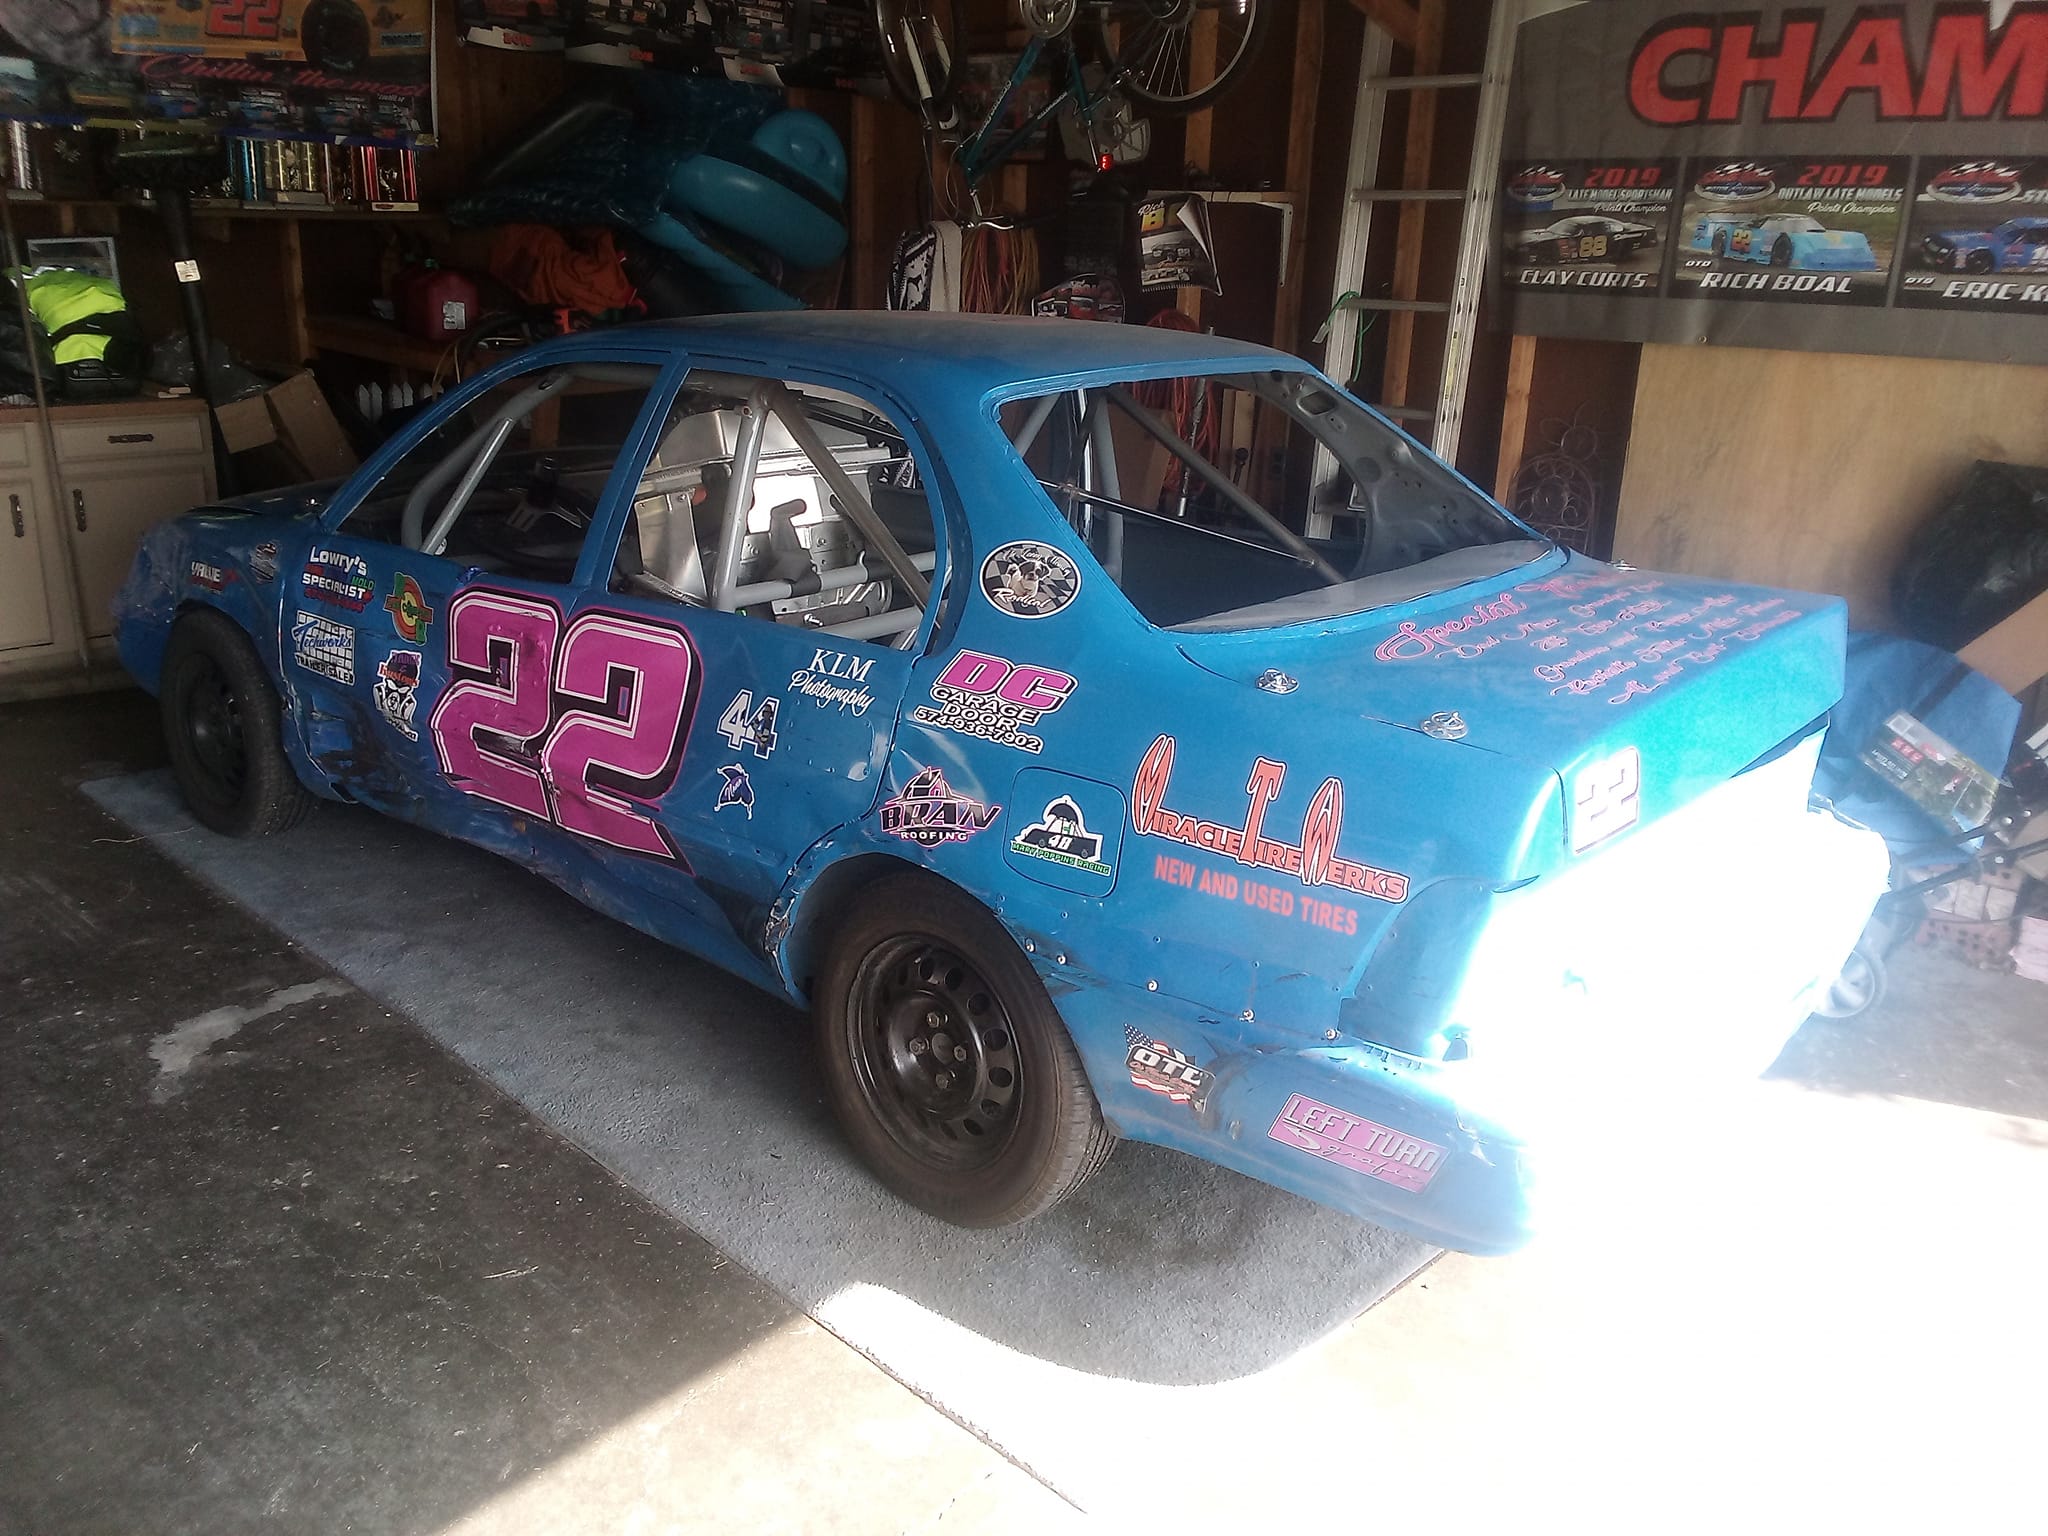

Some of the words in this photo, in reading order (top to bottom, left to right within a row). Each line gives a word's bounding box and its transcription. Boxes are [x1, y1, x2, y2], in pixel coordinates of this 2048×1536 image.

[1584, 167, 1662, 188] 2019
[1796, 164, 1889, 186] 2019
[1568, 188, 1590, 200] LATE
[1623, 202, 1668, 214] Champion
[1777, 187, 1826, 200] OUTLAW
[1826, 187, 1854, 200] LATE
[1855, 187, 1904, 202] MODELS
[1806, 201, 1842, 215] Points
[1841, 201, 1896, 216] Champion
[1578, 235, 1608, 258] 88
[1519, 269, 1575, 286] CLAY
[1576, 270, 1650, 289] CURTS
[1700, 271, 1769, 291] RICH
[1771, 274, 1853, 294] BOAL
[1942, 280, 2019, 301] ERIC
[191, 560, 221, 583] VALUE
[309, 545, 368, 577] Lowry's
[302, 572, 367, 601] SPECIALIST
[1375, 591, 1528, 662] Special
[806, 648, 877, 683] KLM
[788, 669, 876, 717] Photography
[935, 650, 1078, 713] DC
[932, 686, 1040, 723] GARAGE
[944, 703, 1019, 732] DOOR
[430, 584, 704, 877] 22
[716, 688, 780, 760] 44
[914, 706, 1043, 751] 574-936-7902
[880, 801, 1001, 832] BRAN
[900, 830, 968, 842] ROOFING
[1011, 842, 1037, 856] MARY
[1037, 848, 1076, 866] POPPINS
[1076, 858, 1111, 878] RACING
[1154, 854, 1197, 889] NEW
[1198, 868, 1239, 901] AND
[1243, 880, 1295, 917] USED
[1300, 895, 1358, 936] TIRES
[1282, 1098, 1361, 1142] LEFT
[1365, 1127, 1442, 1173] TURN
